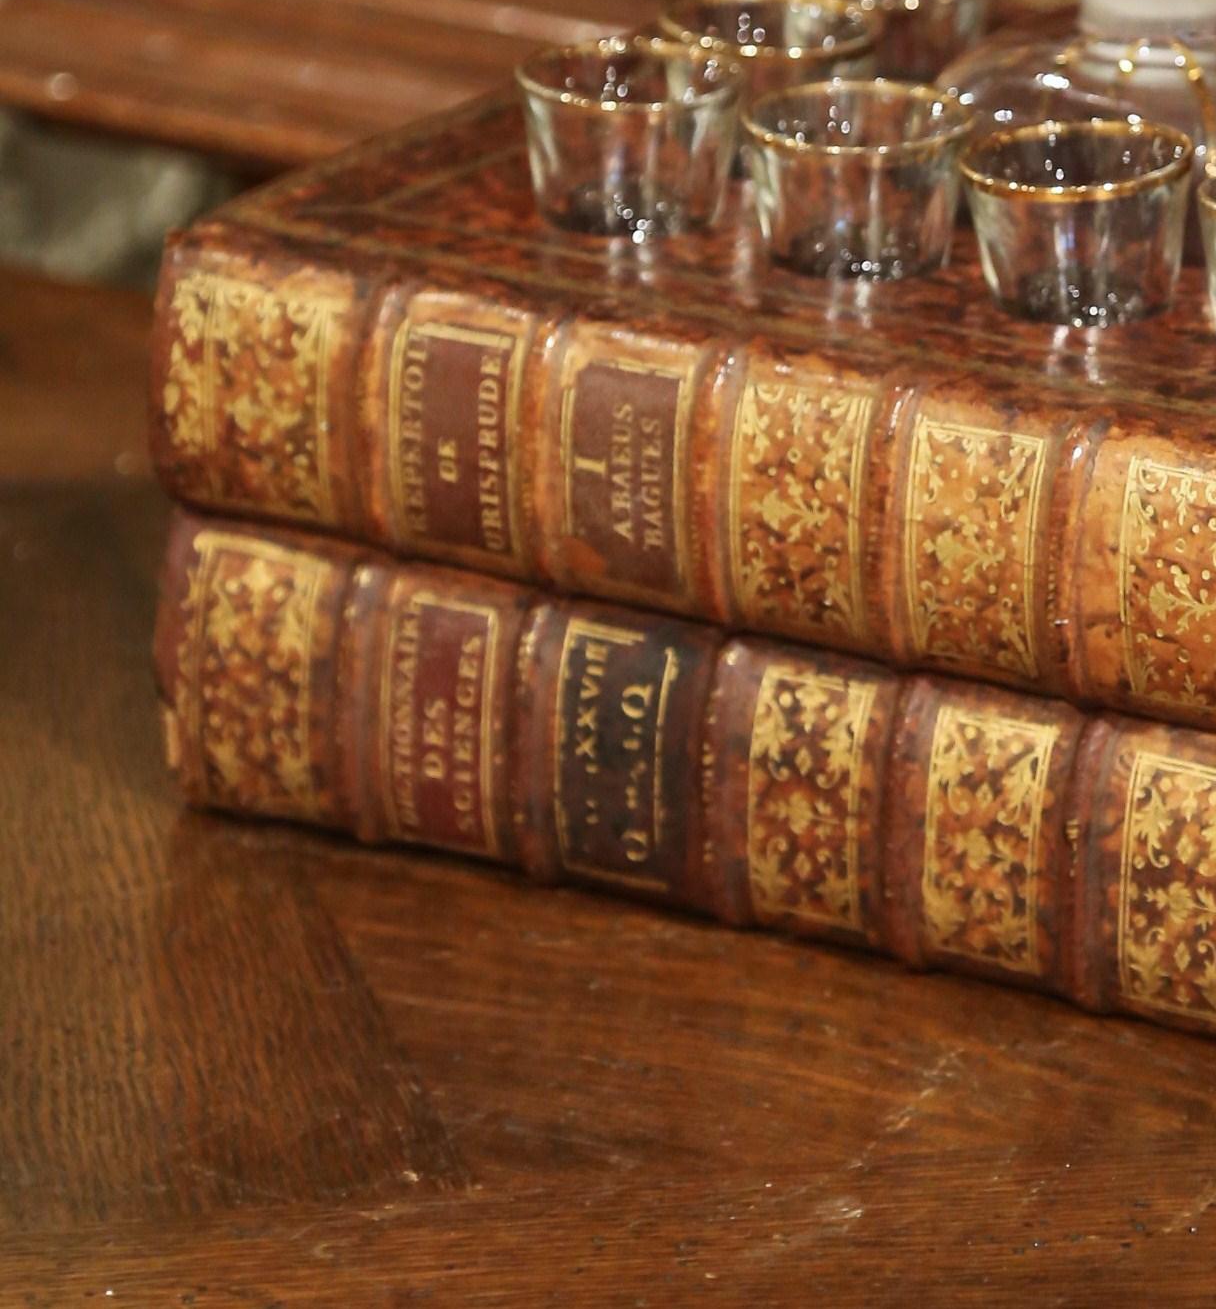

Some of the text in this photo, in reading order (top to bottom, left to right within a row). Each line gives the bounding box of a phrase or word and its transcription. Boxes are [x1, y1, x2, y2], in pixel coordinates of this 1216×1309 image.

[640, 417, 666, 551] BAGUES
[422, 697, 447, 781] DES
[453, 635, 482, 833] SCIENCES
